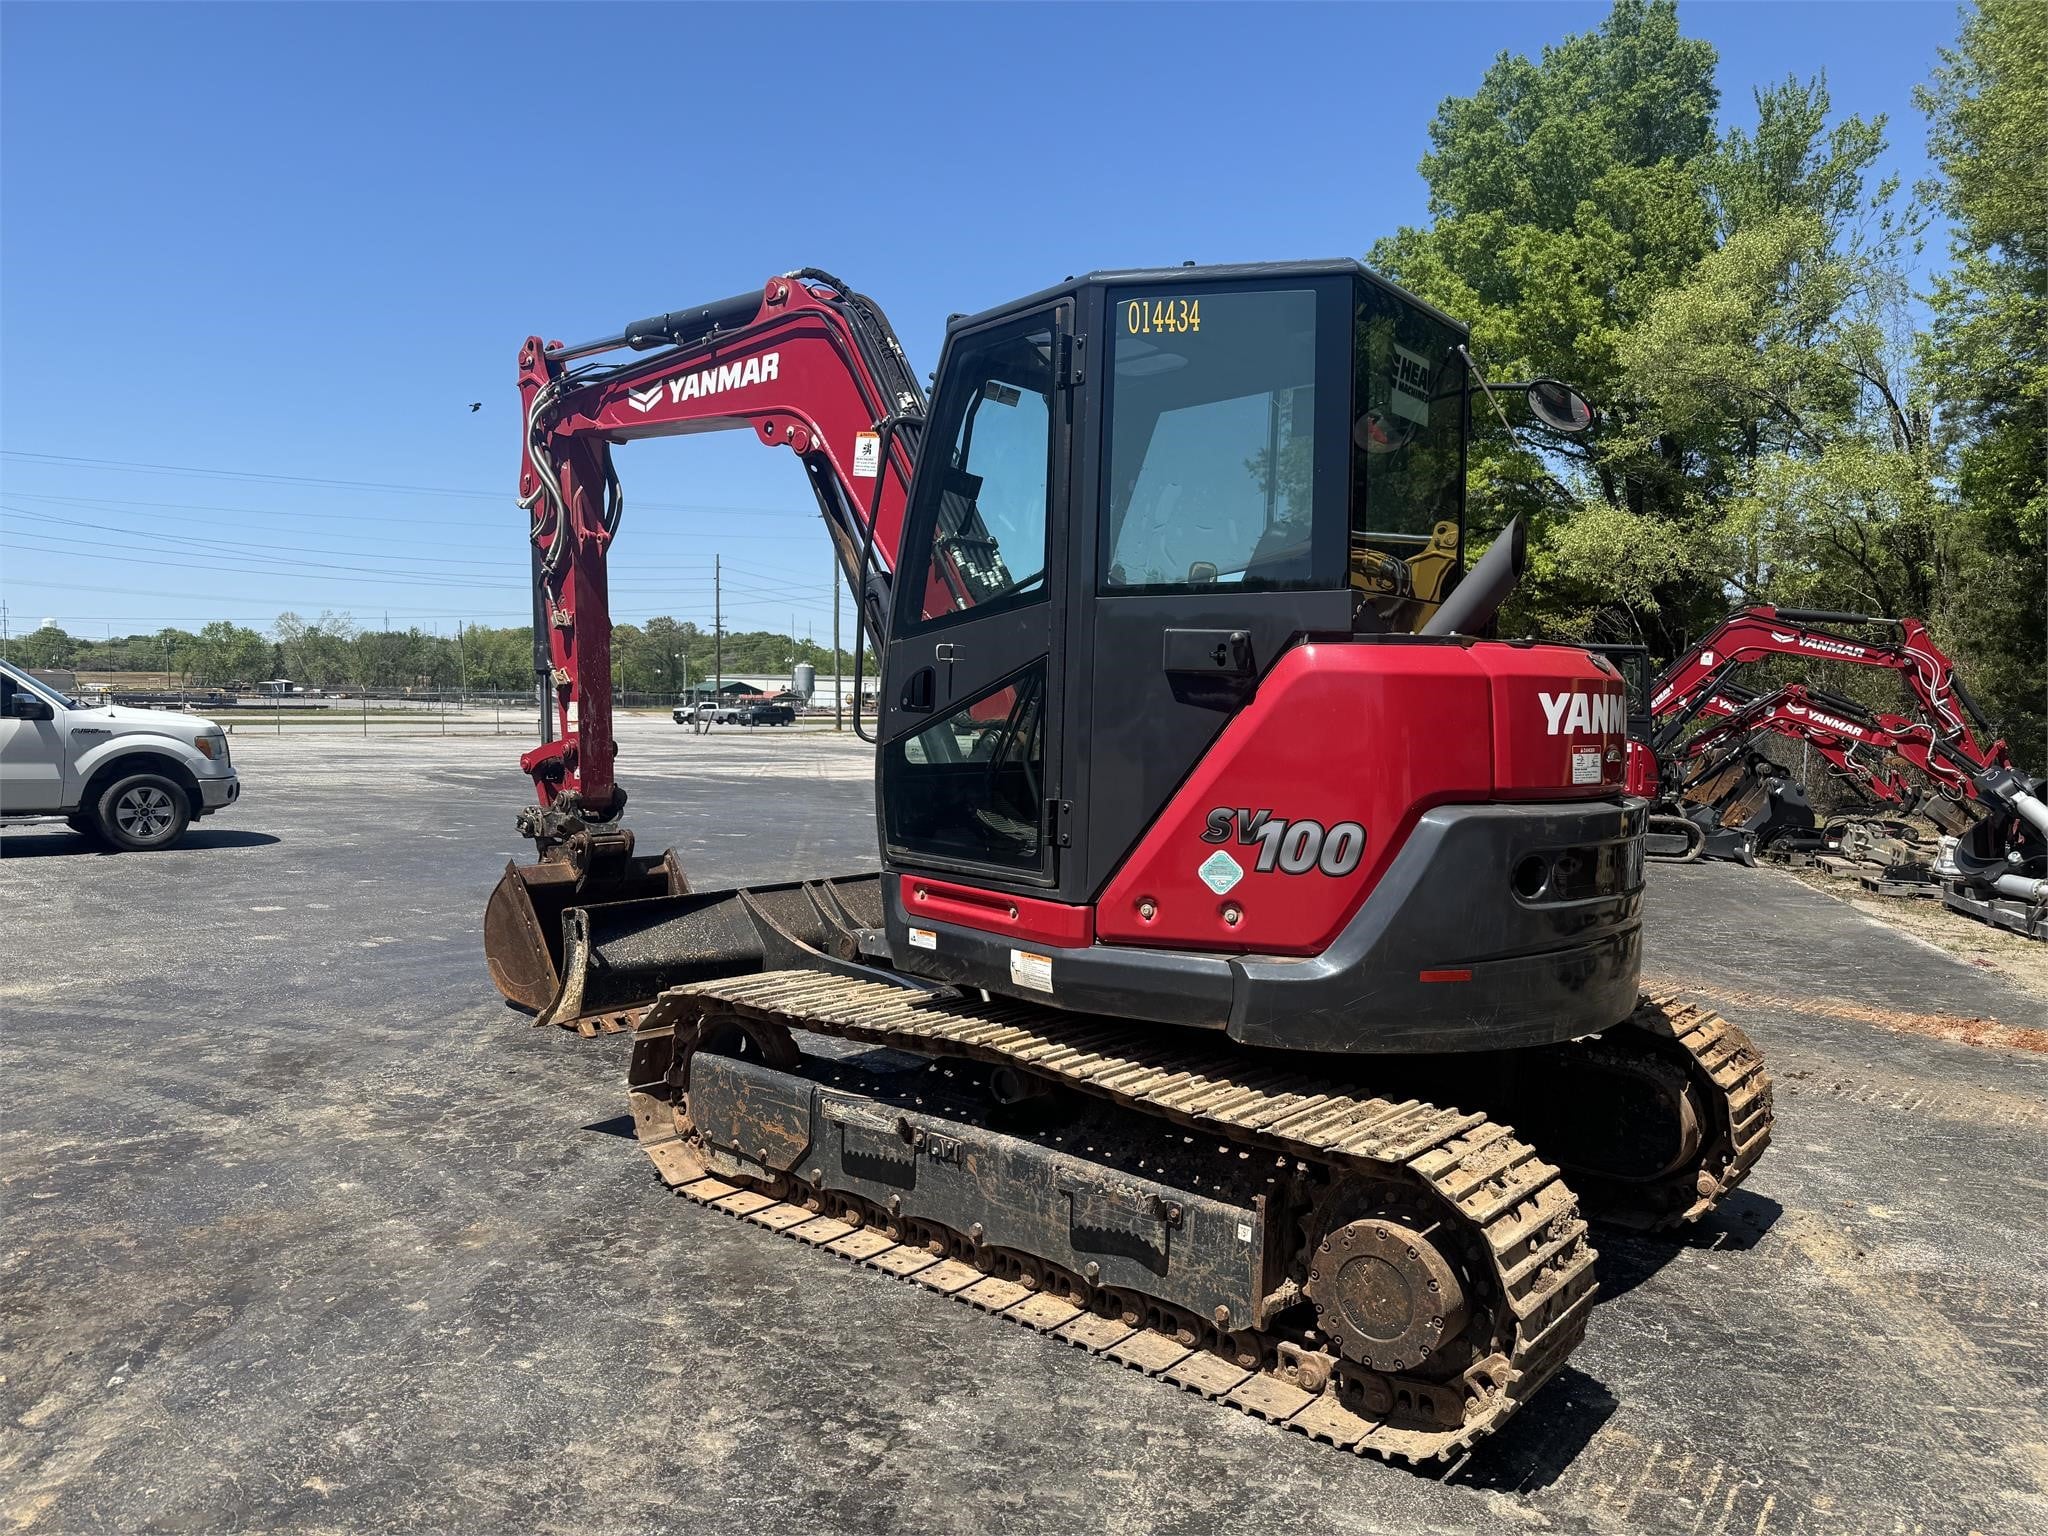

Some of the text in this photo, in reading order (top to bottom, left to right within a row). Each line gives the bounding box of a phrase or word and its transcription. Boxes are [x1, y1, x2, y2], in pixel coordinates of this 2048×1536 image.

[1127, 299, 1201, 334] 014434
[668, 352, 780, 404] YANMAR
[1799, 636, 1866, 658] YANMAR
[1808, 710, 1863, 737] YANMAR
